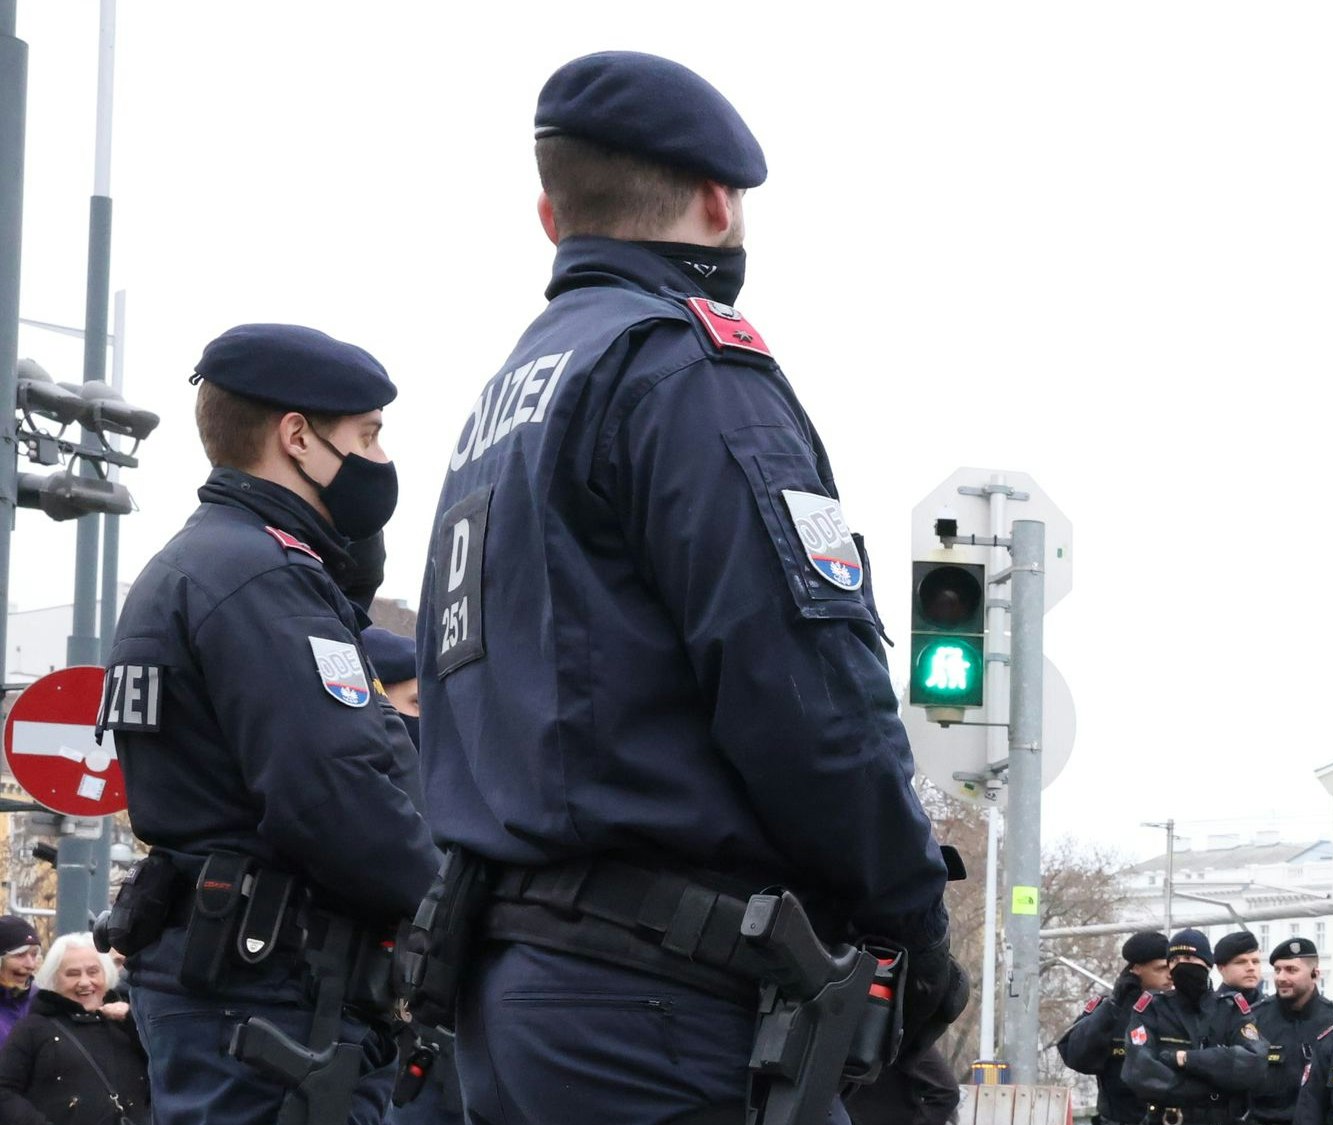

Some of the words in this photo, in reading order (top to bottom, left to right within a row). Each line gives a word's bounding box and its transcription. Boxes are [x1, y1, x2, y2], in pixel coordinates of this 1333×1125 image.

[450, 350, 574, 472] OLIZEI
[448, 518, 470, 593] D
[441, 596, 468, 654] 251
